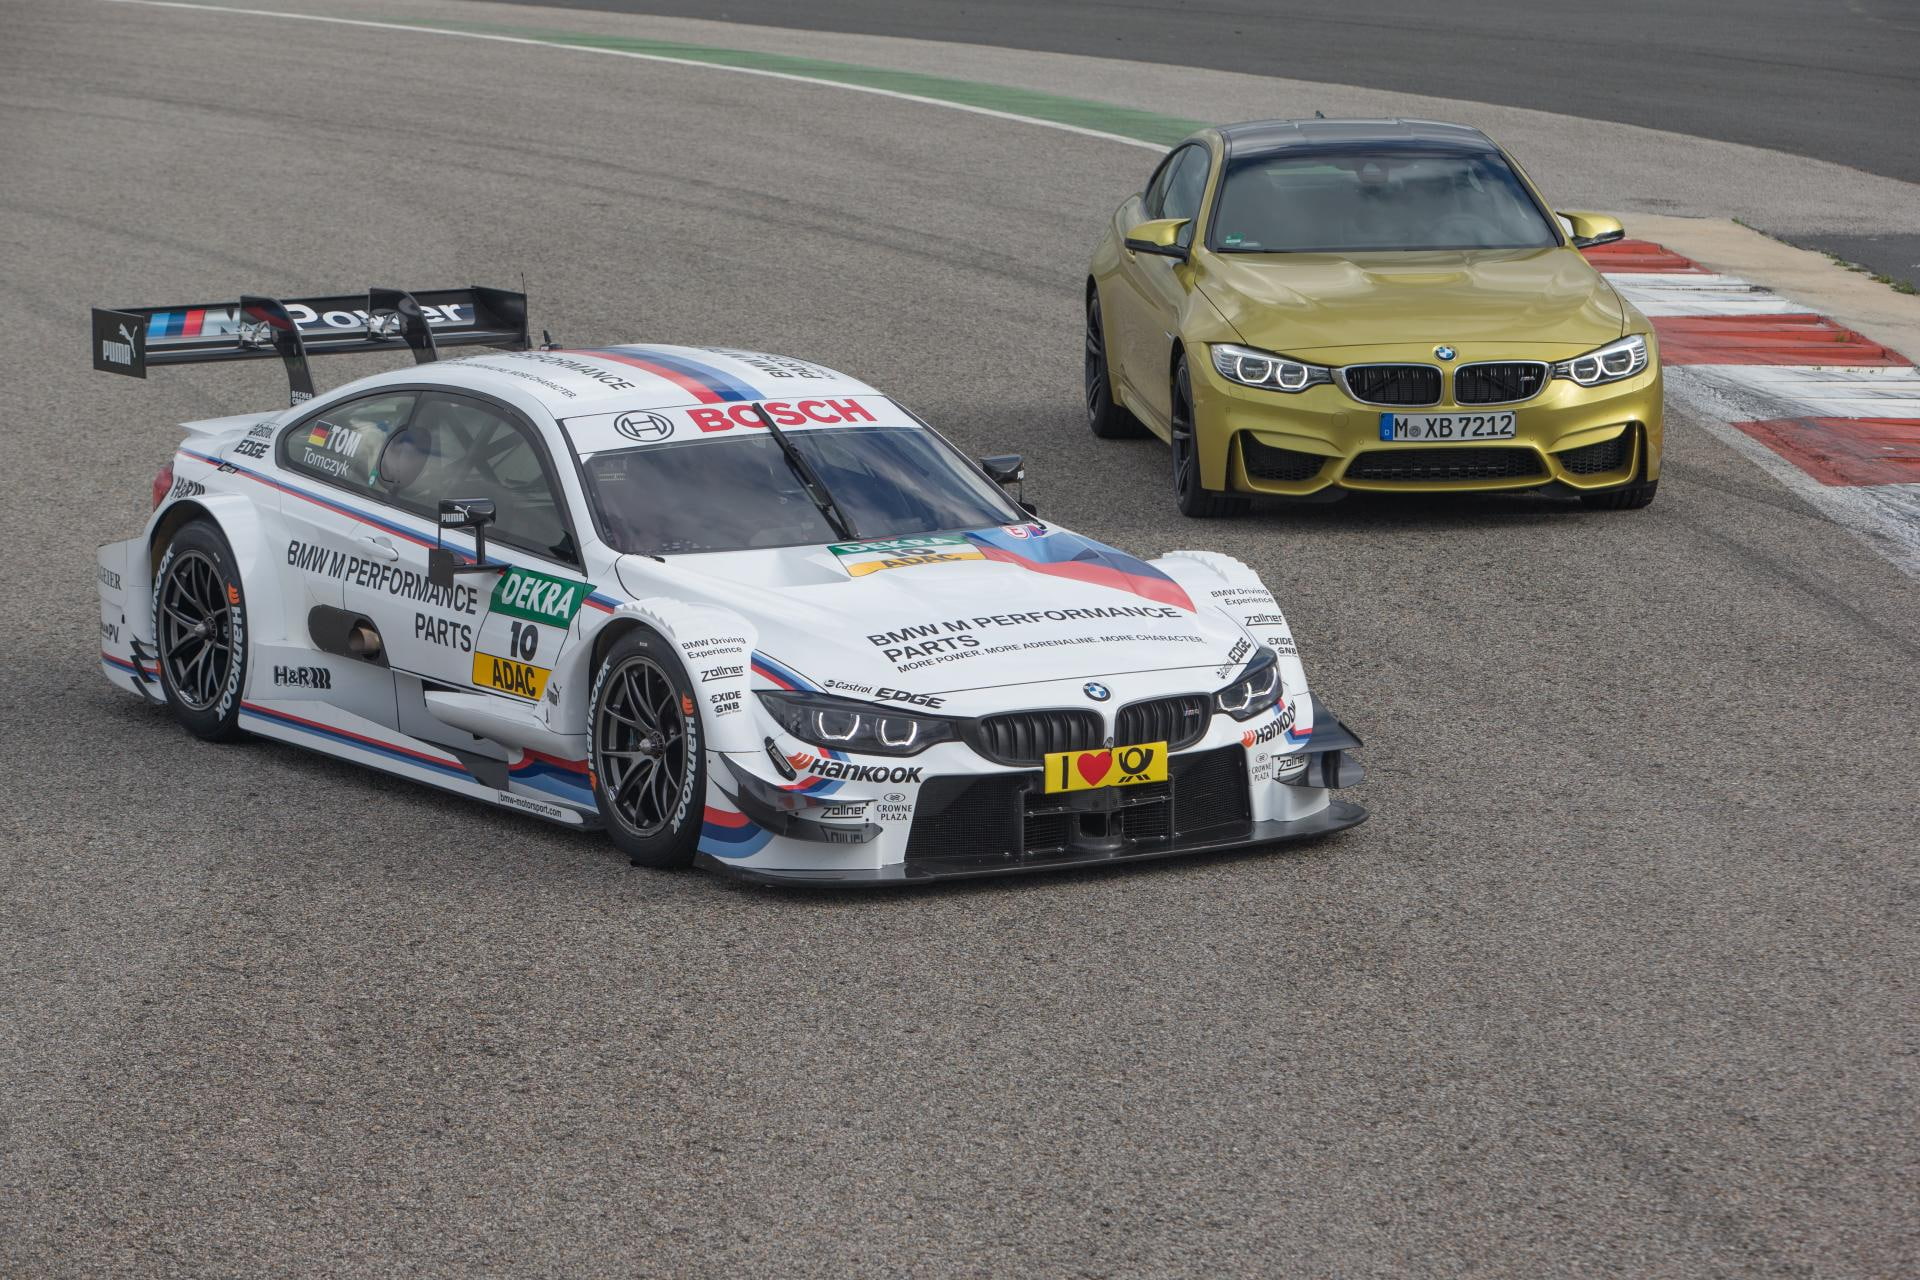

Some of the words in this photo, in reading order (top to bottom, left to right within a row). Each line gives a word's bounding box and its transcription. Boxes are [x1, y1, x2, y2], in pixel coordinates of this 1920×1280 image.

[103, 340, 131, 365] PUMA
[686, 399, 878, 433] BOSCH
[1394, 418, 1408, 438] M
[1425, 418, 1453, 438] XB
[1458, 415, 1513, 437] 7212
[233, 440, 270, 459] EDGE
[326, 425, 362, 458] TOM
[303, 447, 350, 477] Tomczyk
[441, 513, 465, 523] PUMA
[842, 536, 953, 553] DEKRA
[881, 553, 961, 569] ADAC
[287, 540, 330, 573] BMW
[328, 553, 347, 579] M
[345, 556, 478, 615] PERFORMANCE
[501, 574, 575, 619] DEKRA
[1211, 589, 1235, 598] BMW
[1236, 588, 1270, 596] Driving
[1224, 597, 1274, 606] Experience
[415, 612, 472, 652] PARTS
[866, 623, 940, 647] BMW
[941, 619, 973, 632] M
[972, 606, 1183, 629] PERFORMANCE
[511, 621, 539, 661] 10
[682, 639, 710, 649] BMW
[710, 636, 747, 645] Driving
[687, 646, 742, 659] Experience
[883, 635, 980, 663] PARTS
[1228, 637, 1252, 664] EDGE
[1267, 637, 1293, 645] EXIDE
[1277, 647, 1297, 655] GNB
[897, 659, 936, 674] MORE
[937, 649, 985, 664] POWER.
[984, 643, 1022, 655] MORE
[1023, 636, 1100, 649] ADRENALINE.
[1100, 634, 1136, 642] MORE
[1136, 634, 1208, 645] CHARACTER.
[274, 665, 309, 687] H&R
[493, 658, 536, 696] ADAC
[710, 690, 742, 703] EXIDE
[835, 681, 873, 694] Castrol
[875, 687, 947, 709] EDGE
[714, 701, 740, 713] GNB
[1061, 755, 1069, 790] I
[1251, 763, 1272, 774] CROWNE
[500, 794, 562, 818] bmw-motorsport.com
[876, 804, 913, 813] CROWNE
[880, 813, 908, 821] PLAZA
